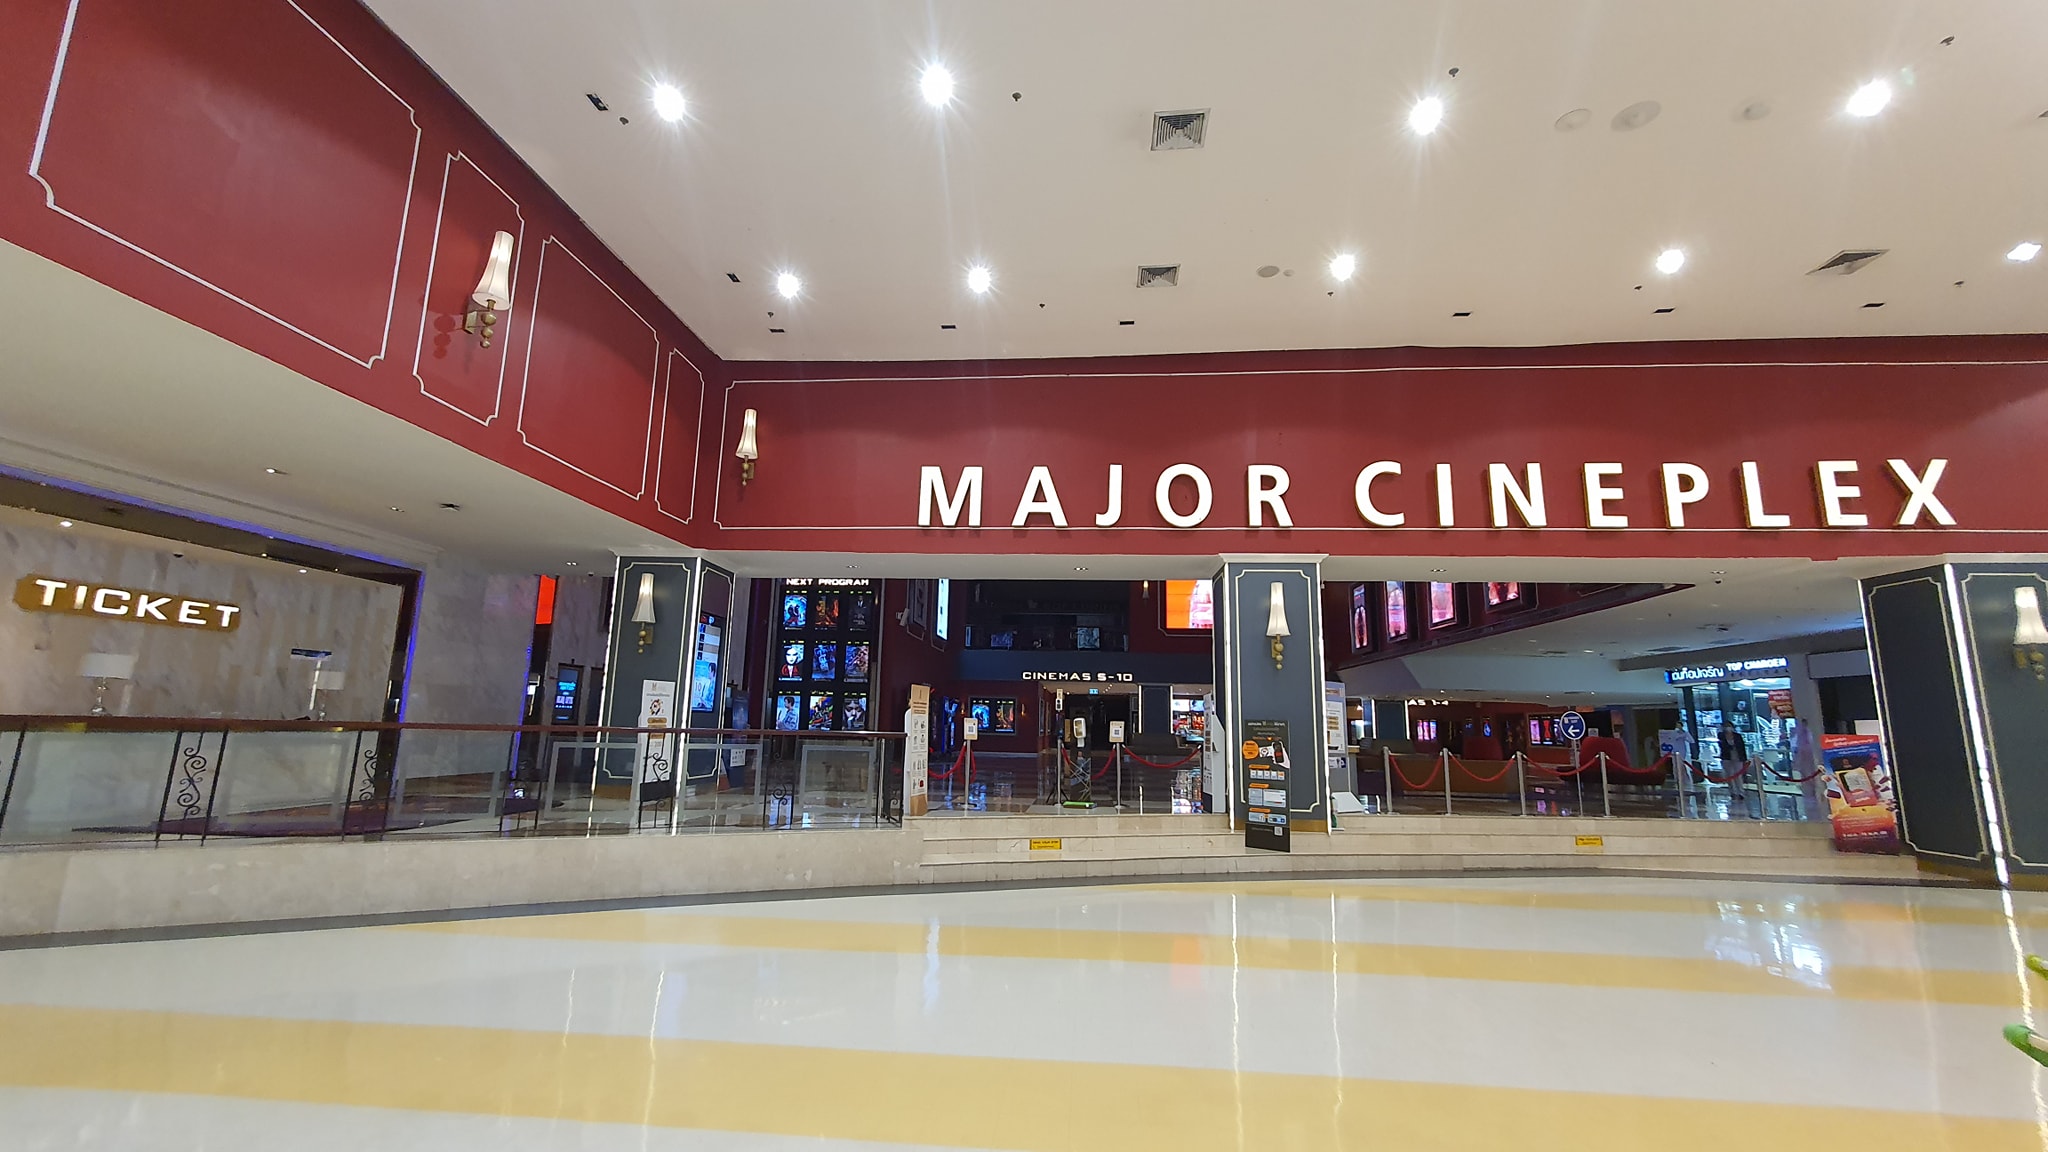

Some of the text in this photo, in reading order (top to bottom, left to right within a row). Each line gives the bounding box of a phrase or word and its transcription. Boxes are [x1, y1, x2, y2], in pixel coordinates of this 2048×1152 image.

[917, 458, 1958, 529] MAJOR CINEPLEX
[786, 578, 869, 586] NEXT PROGRAM
[35, 579, 240, 628] TICKET
[1725, 662, 1743, 671] TOP
[1022, 671, 1092, 681] CINEMAS
